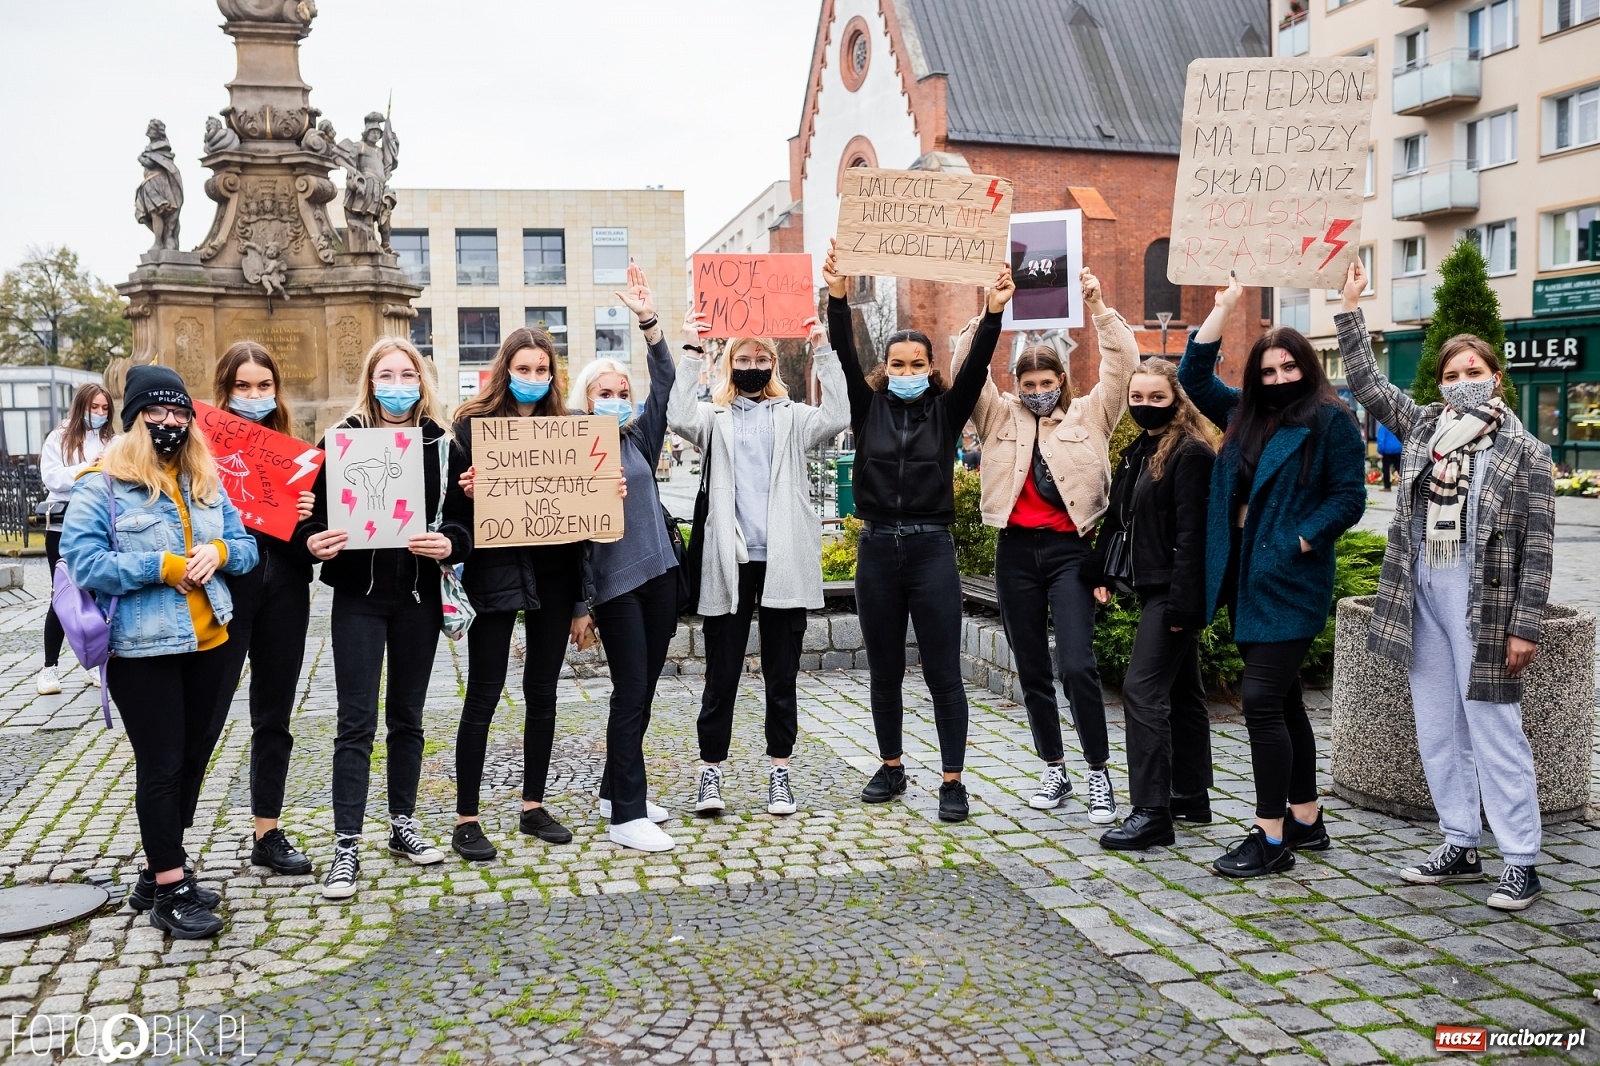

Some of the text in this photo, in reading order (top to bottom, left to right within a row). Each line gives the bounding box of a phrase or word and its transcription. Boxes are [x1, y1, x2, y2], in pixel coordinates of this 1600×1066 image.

[1197, 69, 1366, 115] MEFEDRON
[1193, 125, 1358, 159] MA LEPSZY
[859, 176, 975, 201] WALCZCIE Z
[1192, 162, 1354, 197] SKŁAD NIŻ
[862, 202, 991, 229] WIRUSEM, NIE
[1201, 199, 1328, 231] POLSKI
[852, 231, 995, 265] Z KOBIETAMI
[699, 260, 811, 296] MOJE CIAŁO
[204, 410, 274, 447] CHCEMY
[482, 420, 589, 441] NIE MACIE
[259, 448, 293, 470] TEGO
[485, 448, 577, 470] SUMIENIA
[486, 475, 599, 497] ZMUSZAJĄC
[524, 497, 561, 517] NAS
[479, 513, 611, 542] DO RODZENIA
